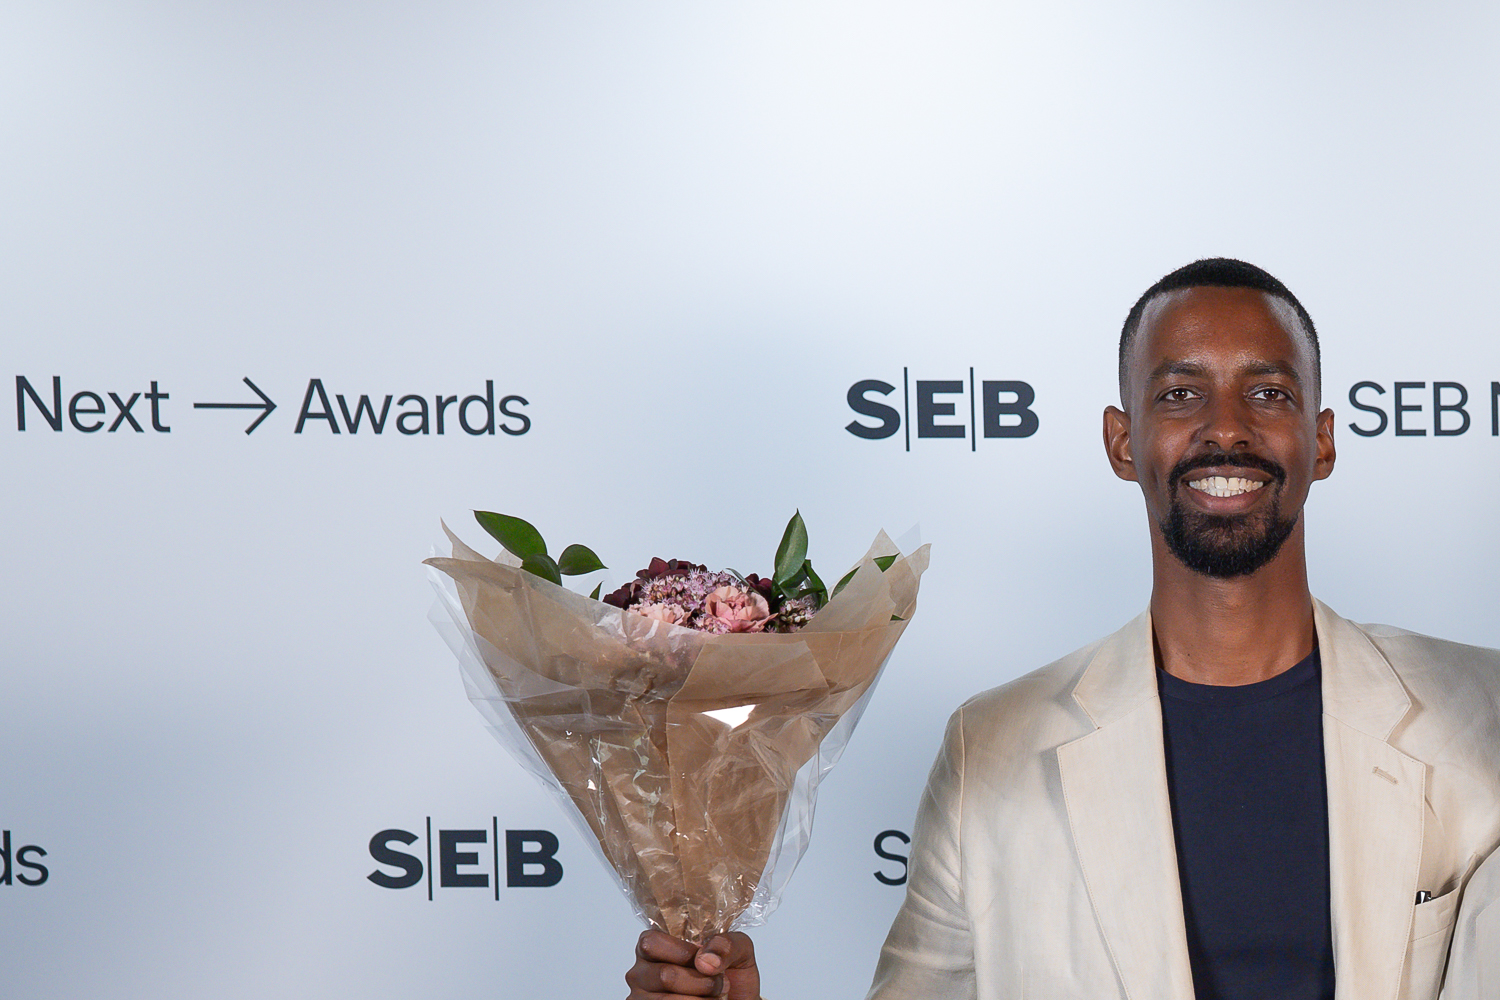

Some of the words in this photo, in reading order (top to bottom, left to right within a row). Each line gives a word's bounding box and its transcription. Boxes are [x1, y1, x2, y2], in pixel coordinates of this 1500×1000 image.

[16, 376, 170, 432] Next
[295, 379, 531, 436] Awards
[1349, 381, 1470, 437] SEB
